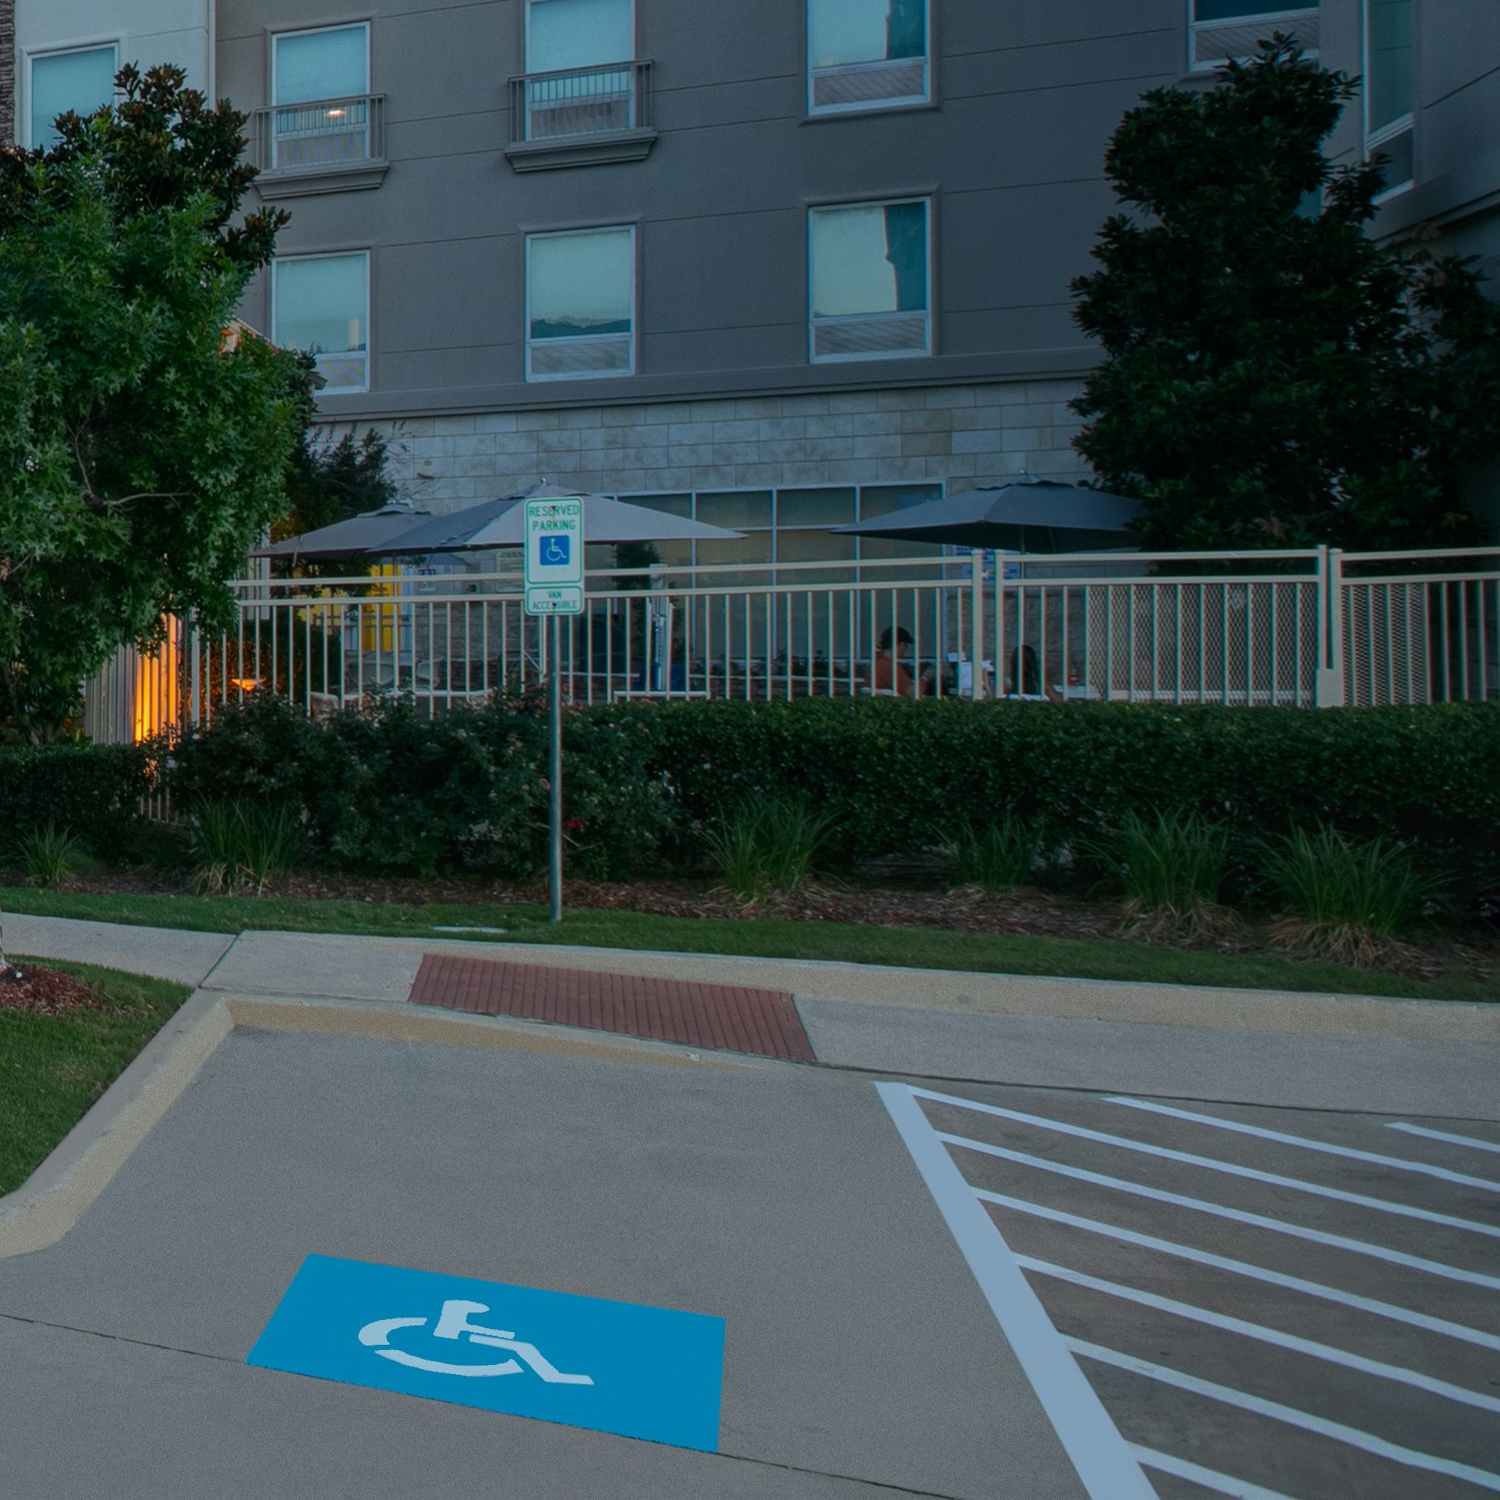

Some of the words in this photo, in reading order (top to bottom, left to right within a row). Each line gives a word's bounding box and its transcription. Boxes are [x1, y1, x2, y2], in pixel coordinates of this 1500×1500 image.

[529, 505, 579, 517] RESERVED
[532, 519, 576, 531] PARKING
[547, 590, 563, 599] VAN
